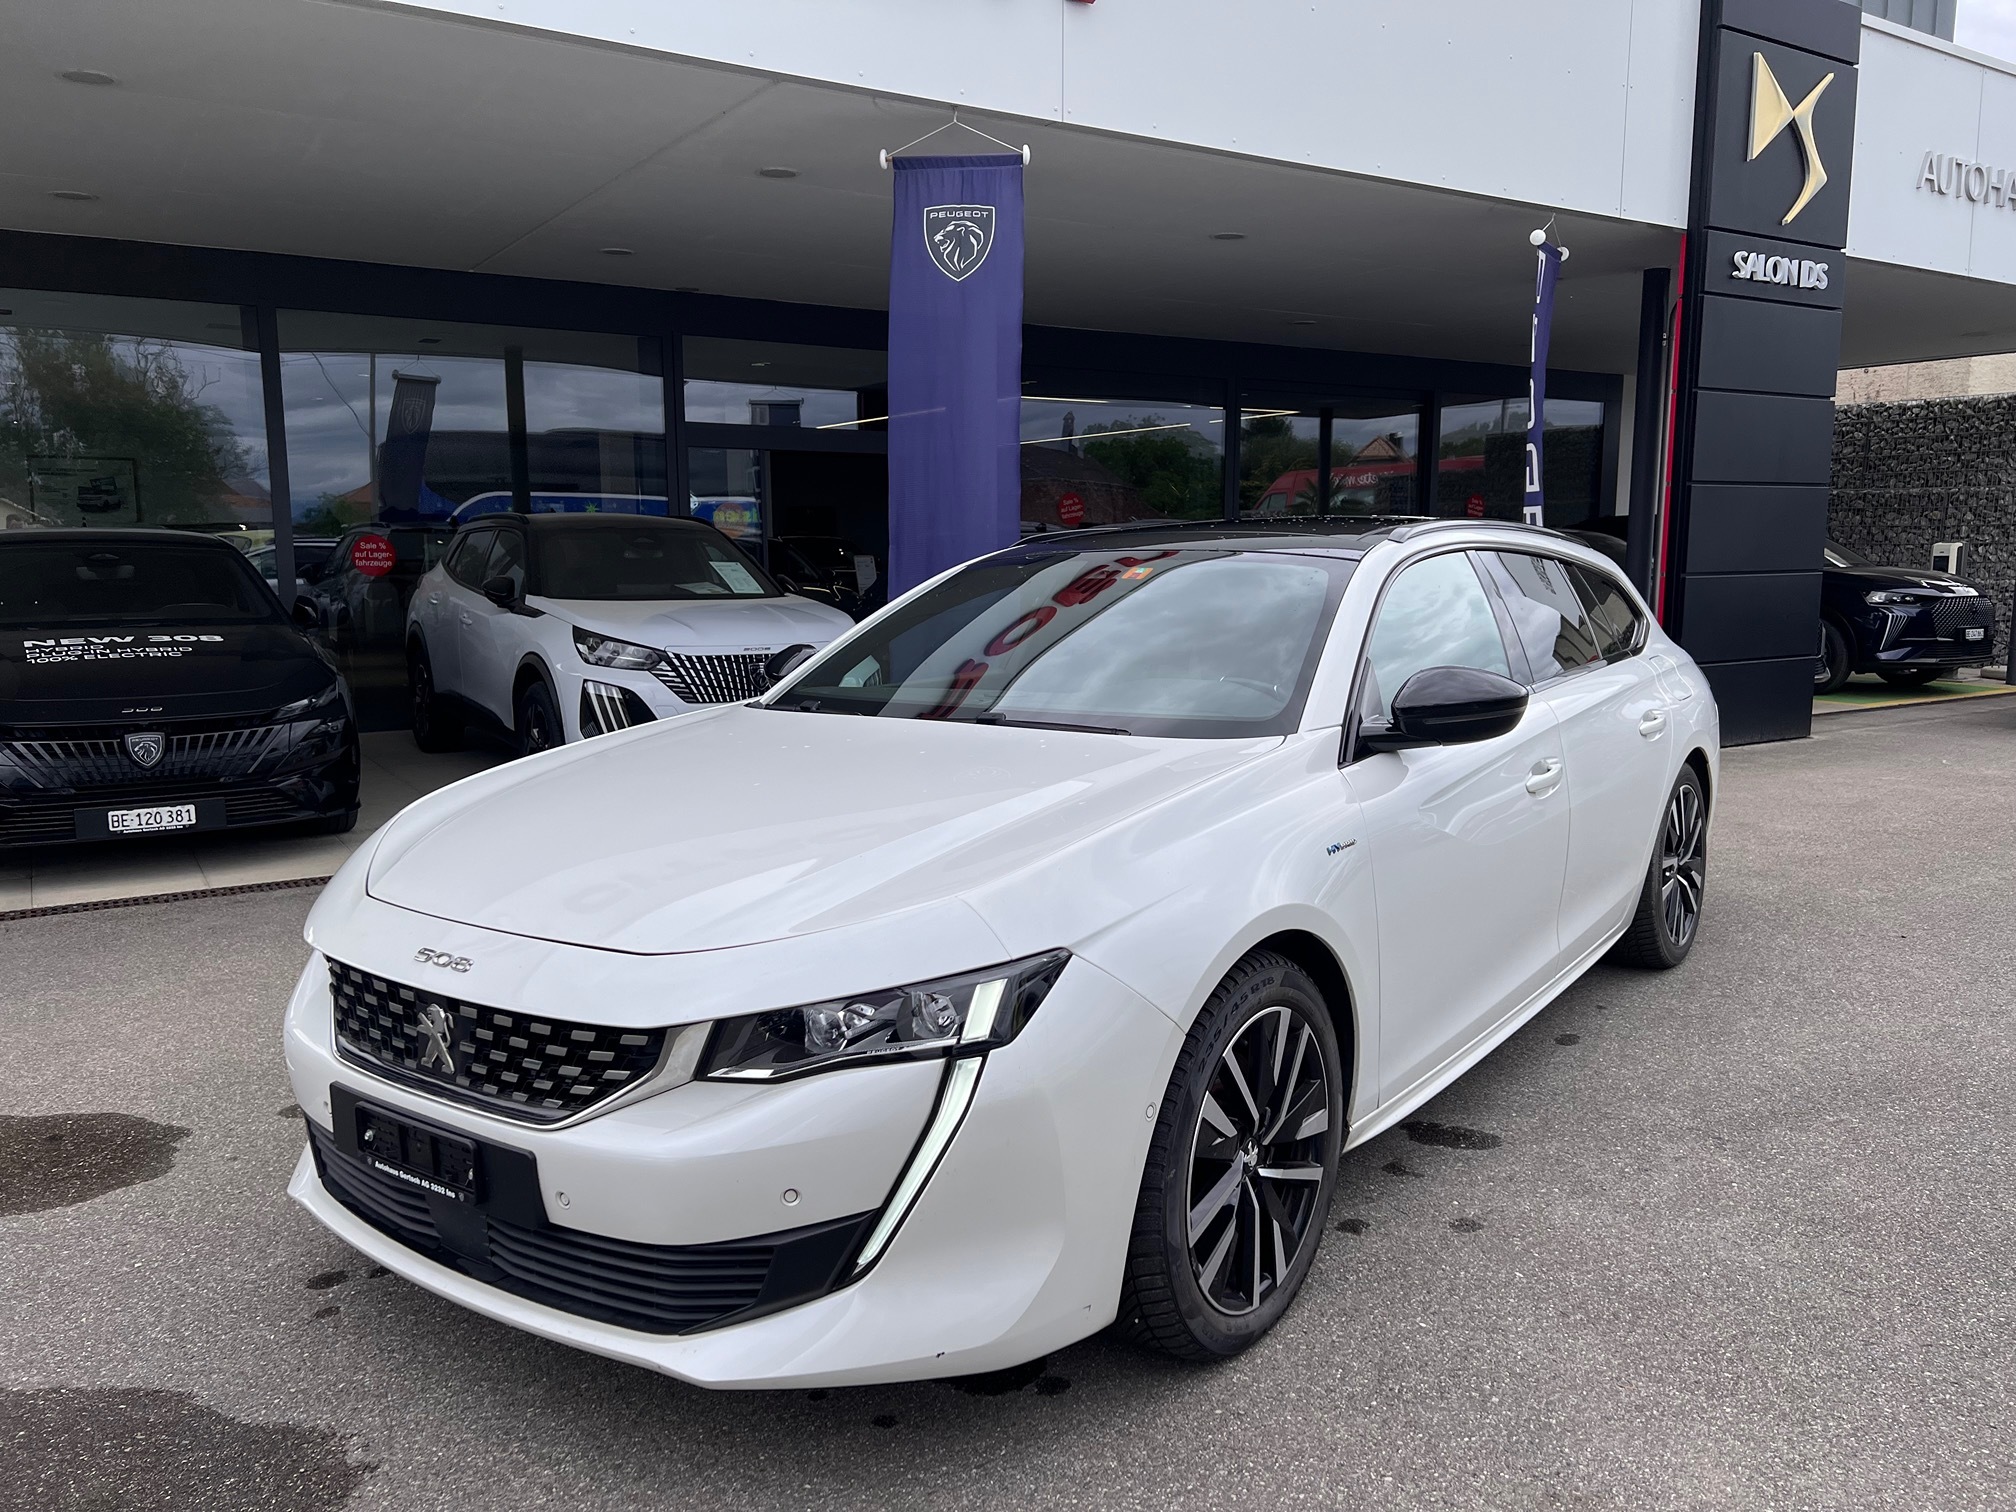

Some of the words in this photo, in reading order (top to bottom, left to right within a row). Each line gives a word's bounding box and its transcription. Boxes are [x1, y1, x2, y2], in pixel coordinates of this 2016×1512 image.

[929, 210, 989, 219] PEUGEOT
[1731, 250, 1799, 286] SALON
[1799, 260, 1829, 290] DS
[360, 541, 376, 549] Sale
[379, 542, 386, 550] %
[368, 551, 392, 559] Lager-
[355, 559, 392, 568] fahrzeuge
[24, 635, 135, 648] NEW
[147, 634, 224, 642] 308
[26, 644, 104, 654] HYBRID
[26, 649, 110, 659] PLUG-IN
[26, 655, 79, 664] 100%
[84, 651, 183, 660] ELECTRIC
[166, 808, 193, 824] 381
[414, 947, 474, 973] 508
[375, 1160, 399, 1177] Autohaus
[421, 1179, 430, 1189] AG
[430, 1182, 446, 1195] 3232
[446, 1188, 456, 1199] Ins
